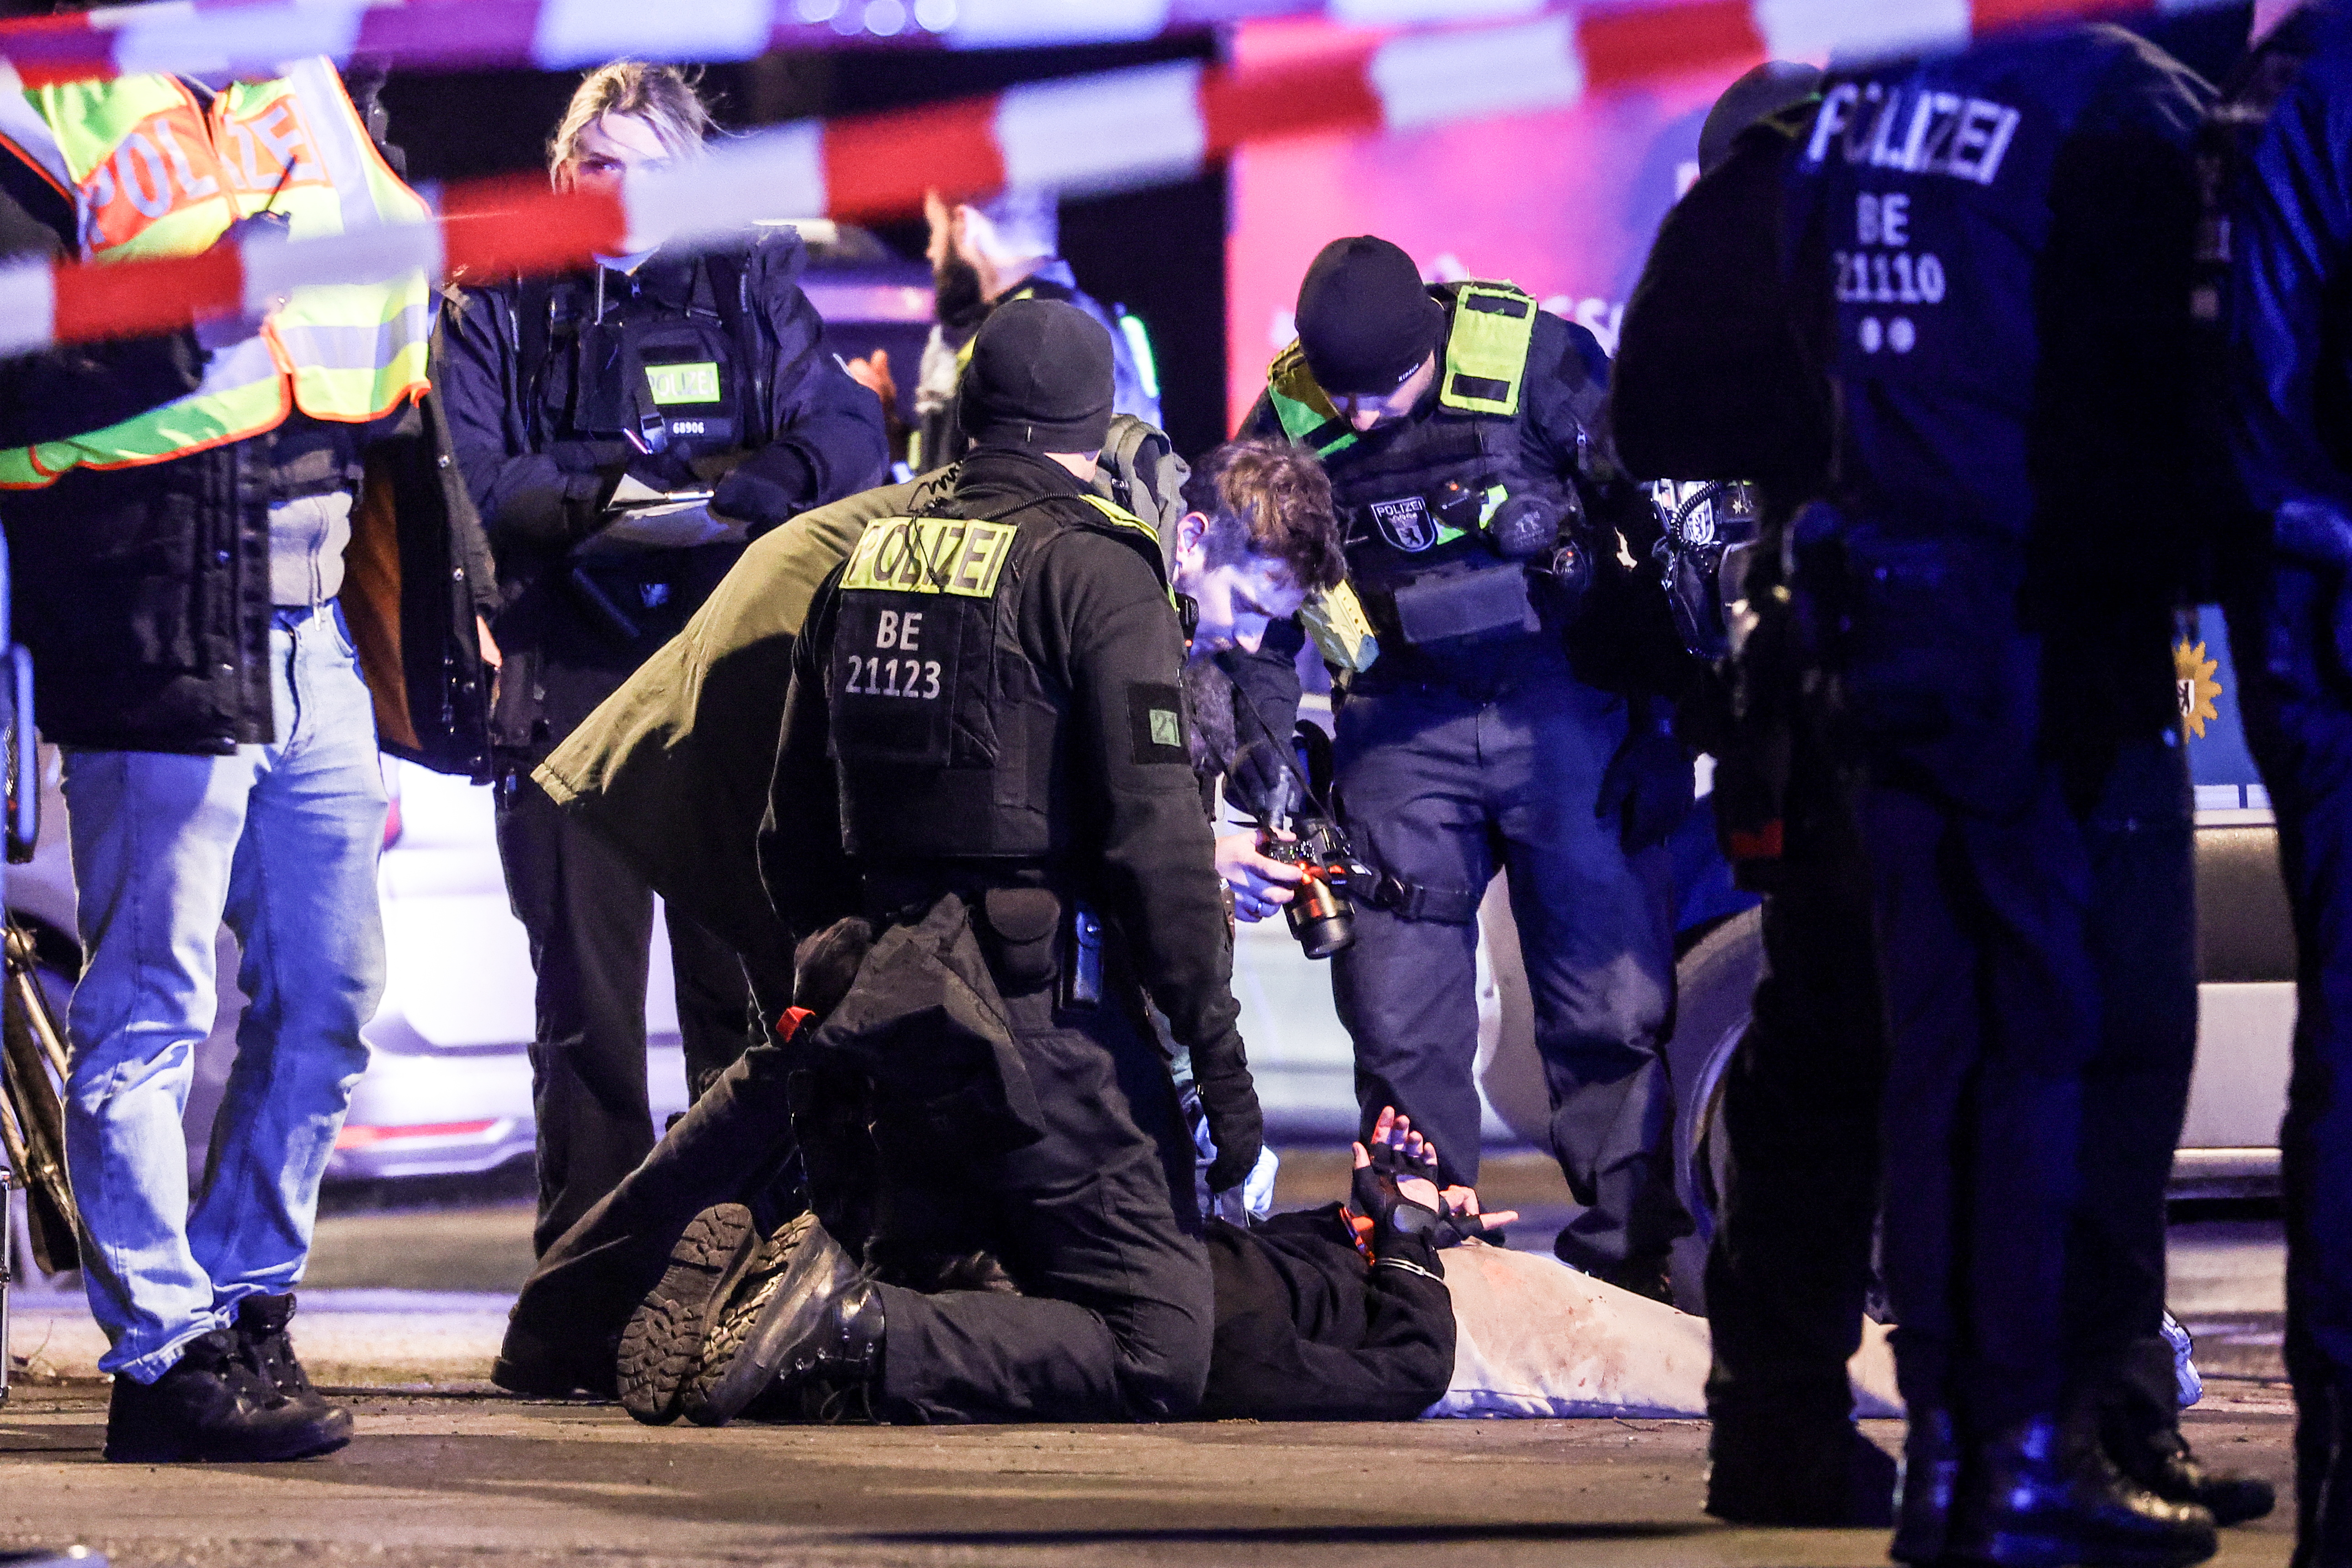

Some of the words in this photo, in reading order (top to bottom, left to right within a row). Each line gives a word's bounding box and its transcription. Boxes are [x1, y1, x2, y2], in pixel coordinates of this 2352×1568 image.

[1857, 193, 1910, 246] BE
[672, 421, 705, 434] 68906
[1376, 500, 1423, 517] POLIZEI
[848, 524, 1008, 590] POLIZEI
[876, 610, 922, 651] BE
[845, 655, 941, 699] 21123
